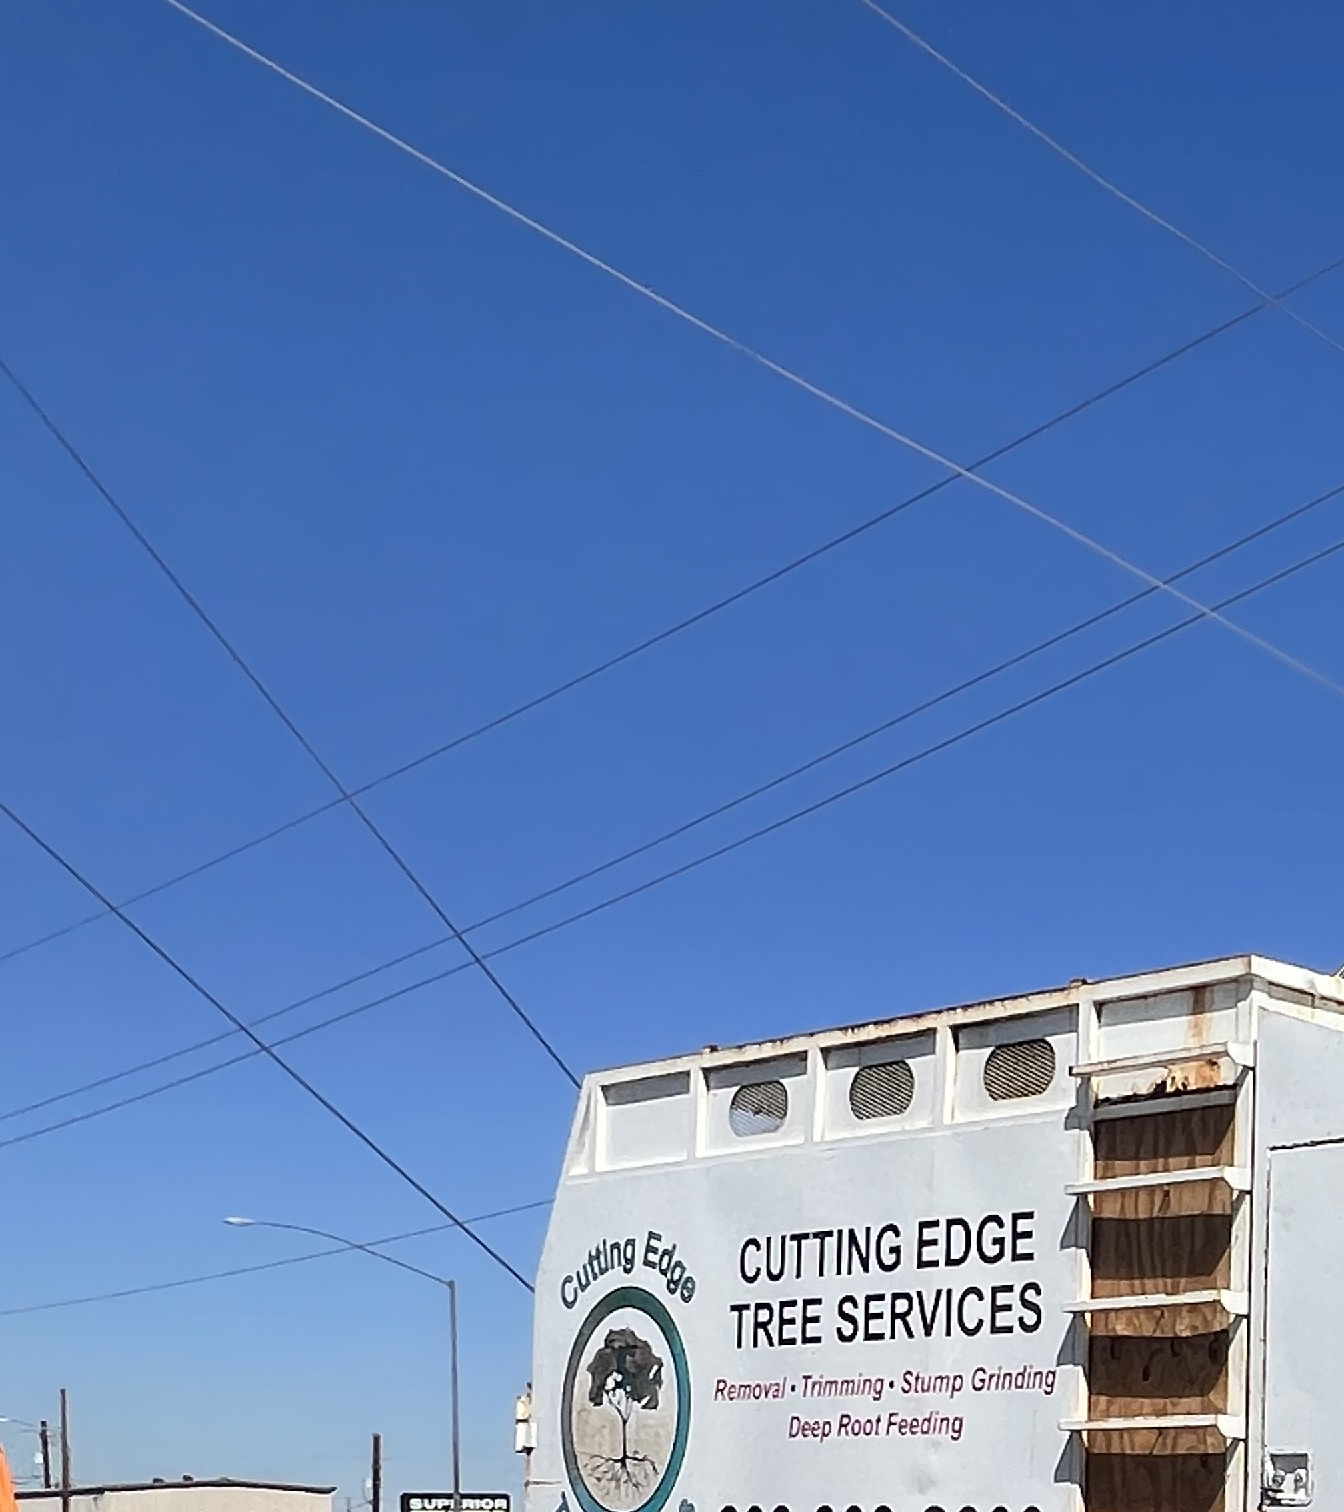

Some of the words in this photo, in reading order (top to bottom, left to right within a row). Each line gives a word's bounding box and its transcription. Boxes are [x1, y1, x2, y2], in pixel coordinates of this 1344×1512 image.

[560, 1238, 636, 1310] Cutting
[642, 1230, 696, 1304] Edge
[740, 1222, 901, 1285] CUTTING
[917, 1211, 1036, 1270] EDGE
[730, 1297, 824, 1350] TREE
[836, 1281, 1043, 1344] SERVICES
[714, 1376, 789, 1402] Removal
[801, 1372, 887, 1402] Trimming
[900, 1370, 965, 1399] Stump
[971, 1365, 1058, 1396] Grinding
[788, 1416, 832, 1443] Deep
[836, 1413, 882, 1439] Root
[885, 1410, 965, 1441] Feeding
